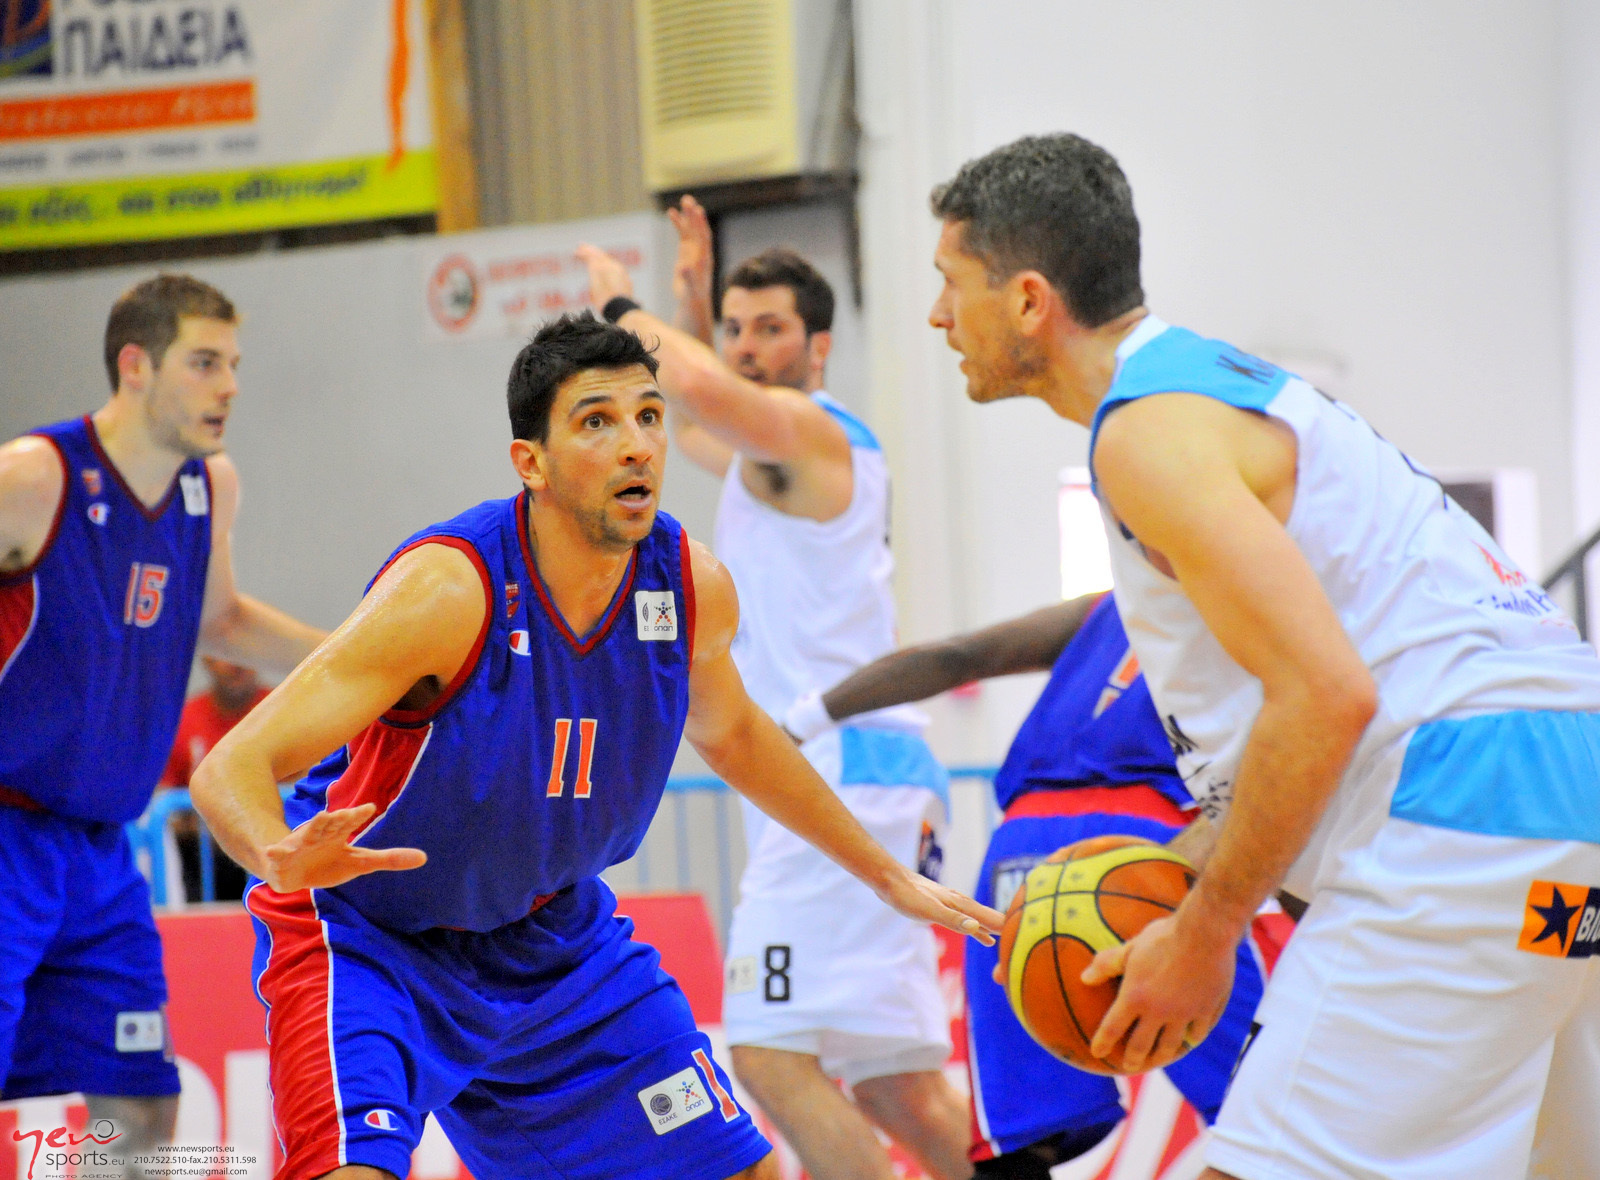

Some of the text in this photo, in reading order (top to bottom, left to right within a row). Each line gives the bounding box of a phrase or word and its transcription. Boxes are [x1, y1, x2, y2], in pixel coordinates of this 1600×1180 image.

[124, 561, 169, 628] 15
[546, 718, 598, 798] 11
[764, 945, 790, 1002] 8
